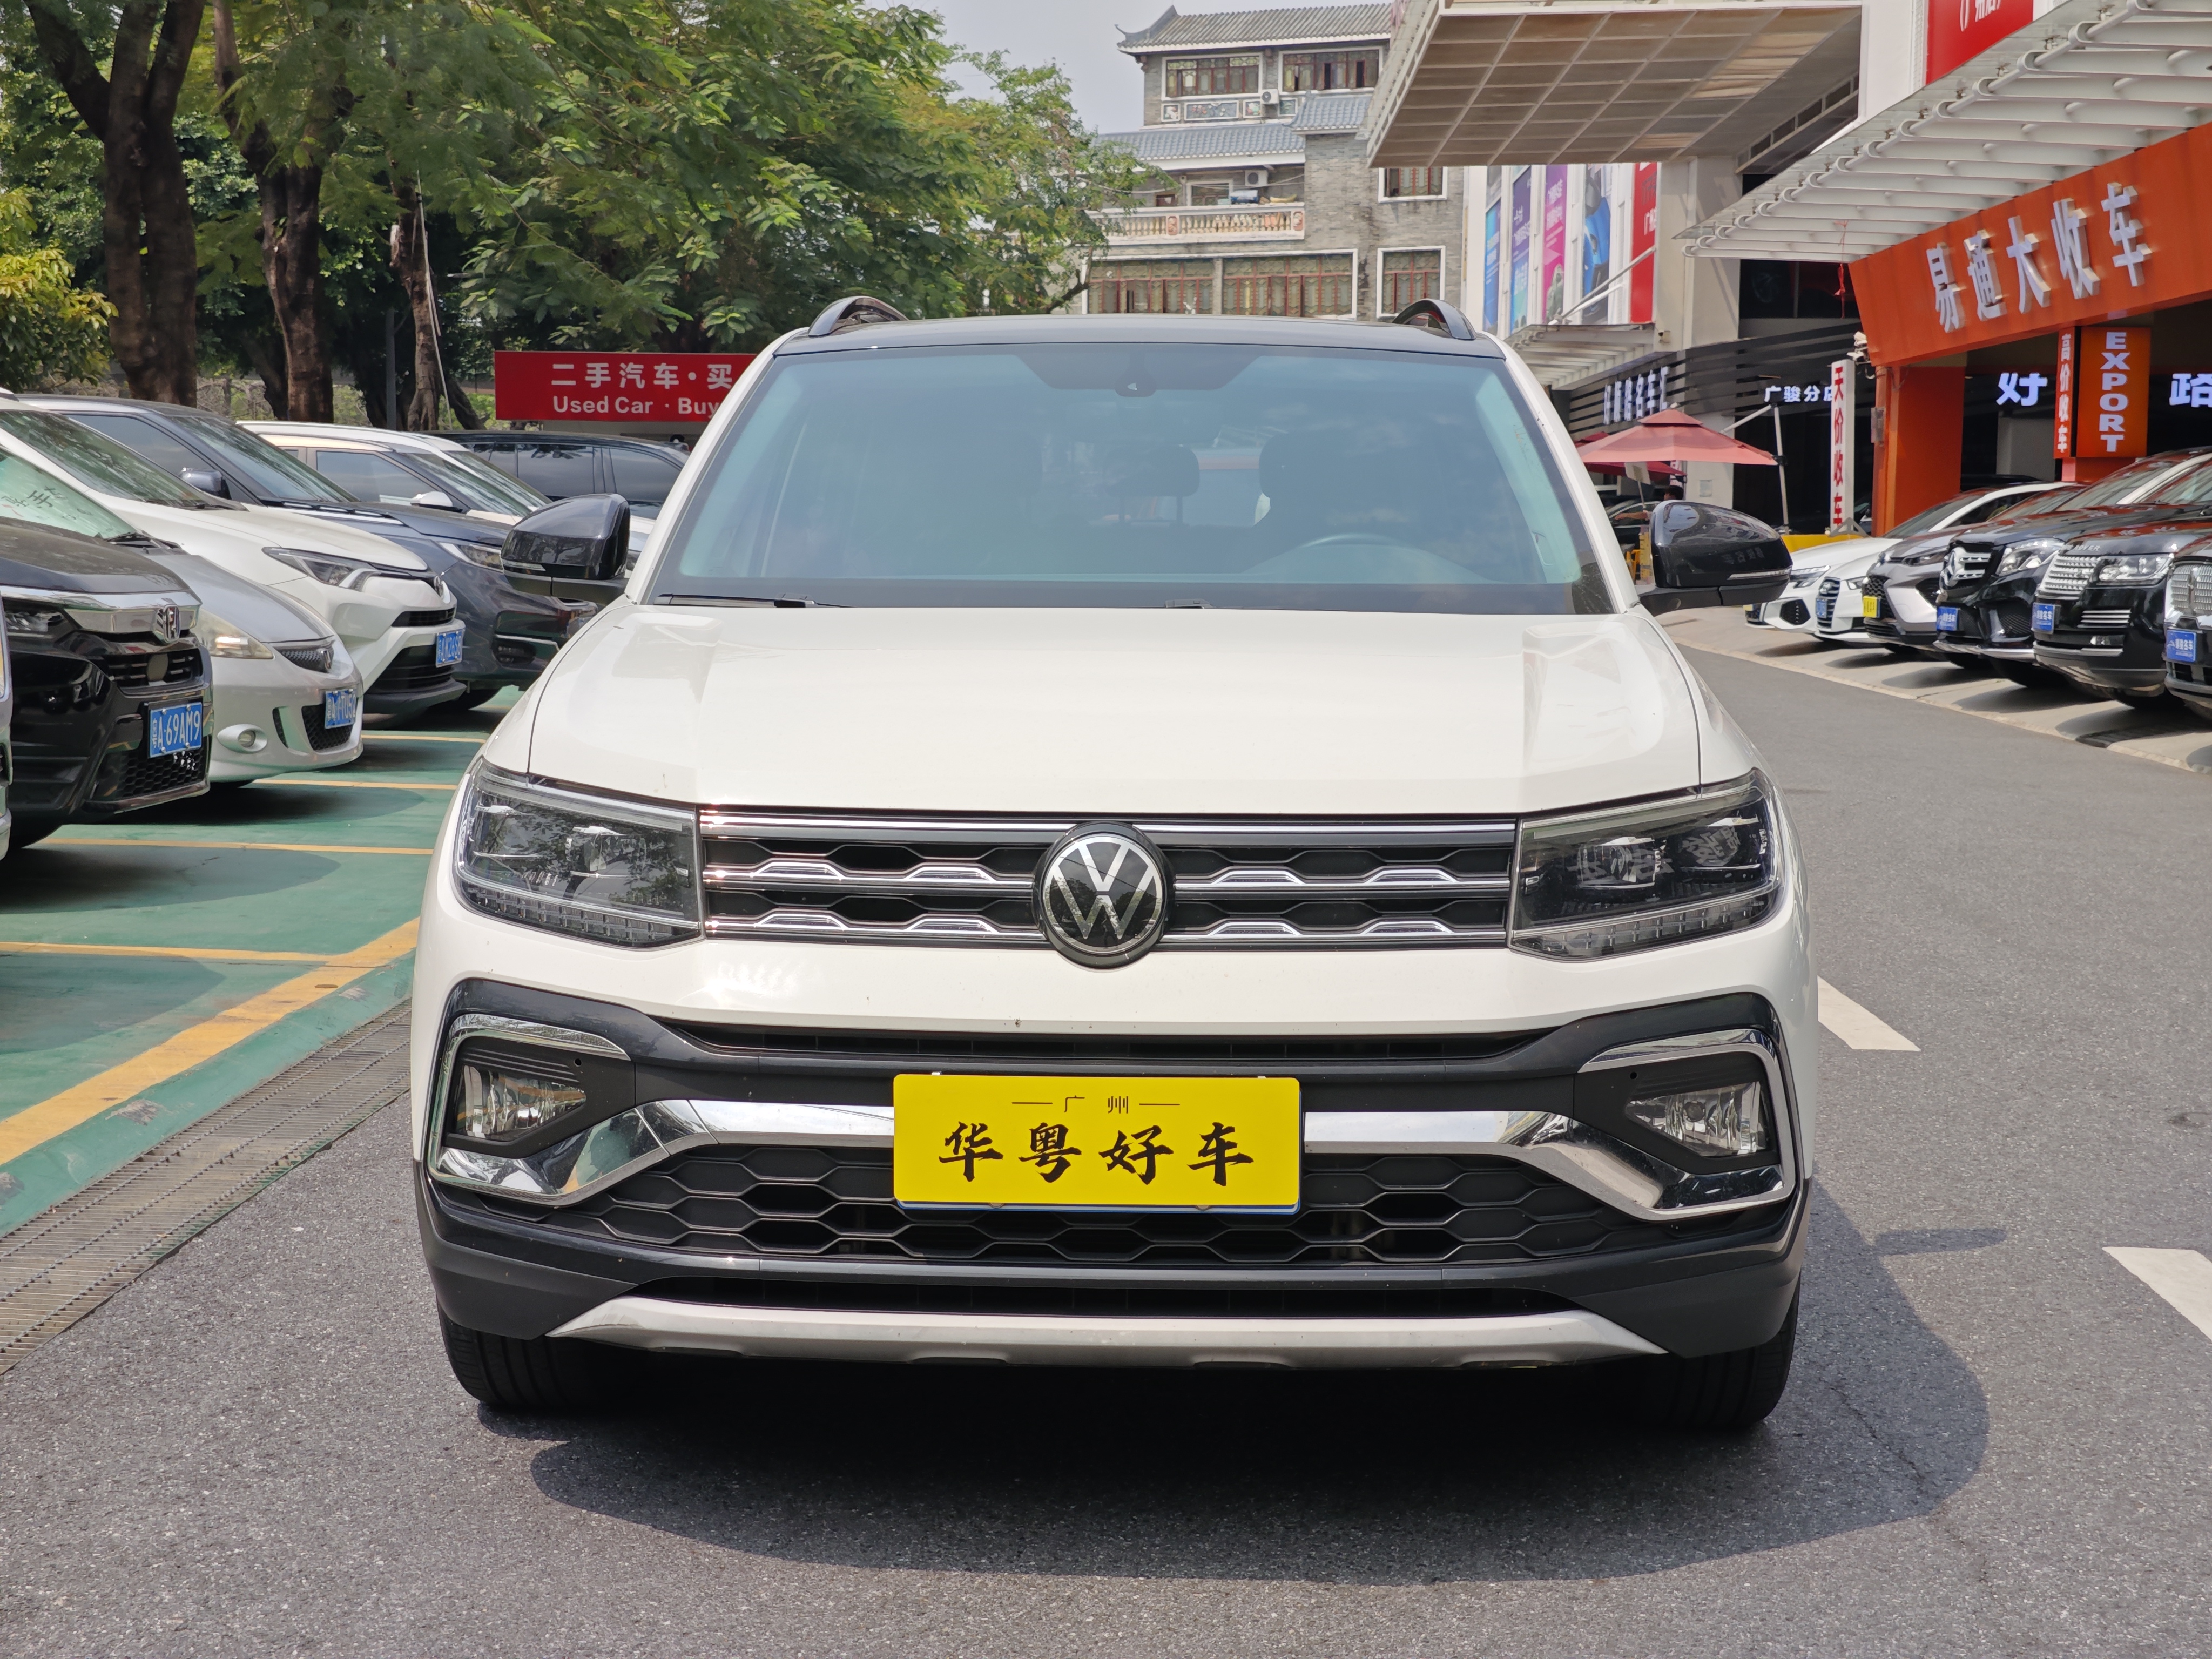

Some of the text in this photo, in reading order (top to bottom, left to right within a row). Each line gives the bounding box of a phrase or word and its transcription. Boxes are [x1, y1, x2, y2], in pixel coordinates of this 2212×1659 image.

[1926, 182, 2153, 333] 易通大收车
[554, 396, 609, 413] Used
[615, 397, 653, 414] Car
[1996, 372, 2048, 406] 好
[2057, 334, 2071, 453] 高价收车
[2099, 332, 2130, 452] EXPORT
[1064, 1095, 1129, 1114] 广州
[939, 1121, 1254, 1186] 华粤好车
